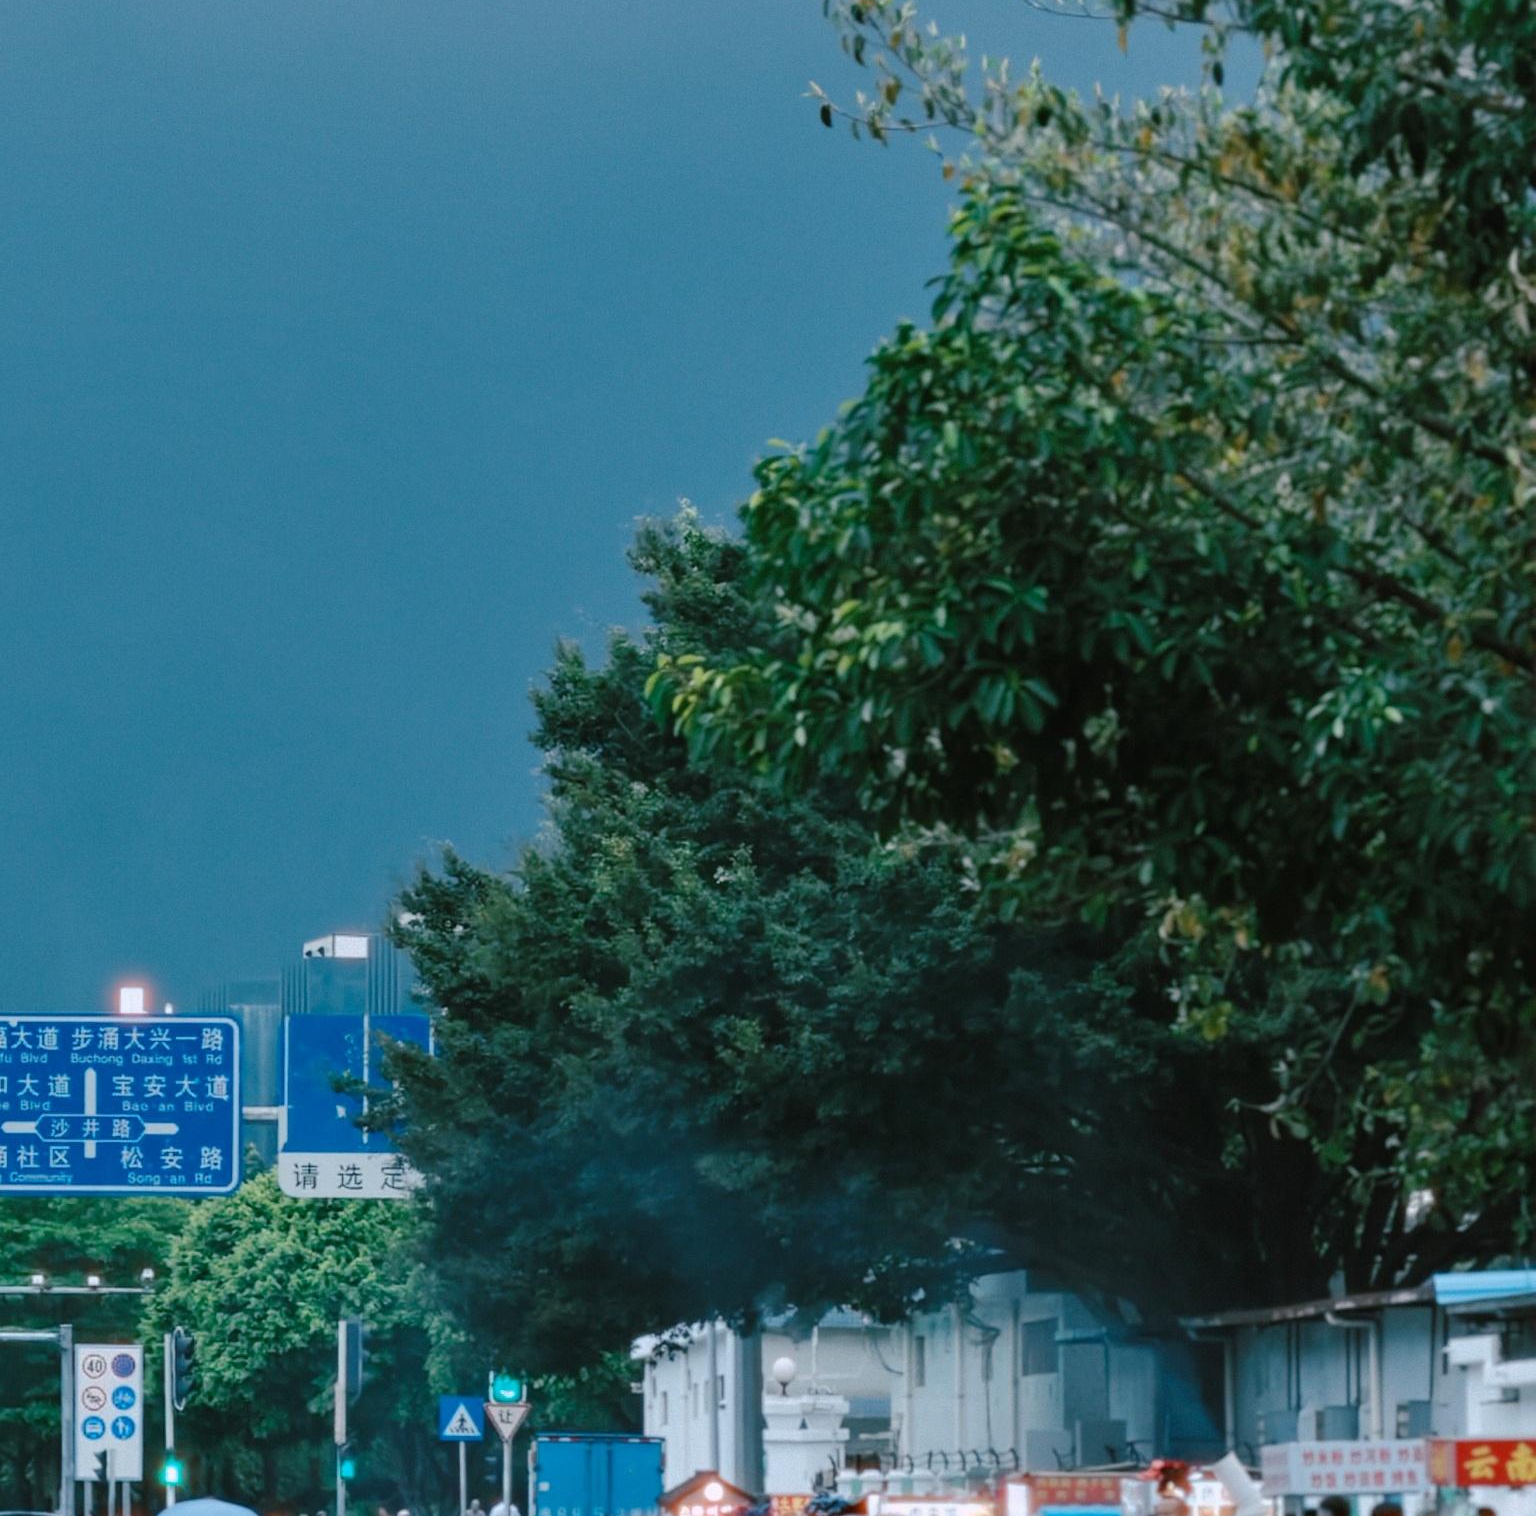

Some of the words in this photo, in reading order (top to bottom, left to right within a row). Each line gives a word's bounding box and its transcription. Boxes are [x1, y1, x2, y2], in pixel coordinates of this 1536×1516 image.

[71, 1026, 224, 1052] 步涌大兴一路
[20, 1051, 48, 1064] Blvd
[70, 1053, 124, 1067] Buchong
[206, 1053, 223, 1065] Rd
[112, 1073, 230, 1101] 宝安大道
[20, 1098, 51, 1111] Blvd
[184, 1100, 214, 1112] Blvd
[50, 1118, 131, 1138] 沙井路
[120, 1145, 224, 1171] 松安路
[194, 1172, 214, 1184] Rd
[86, 1360, 103, 1374] 40
[498, 1408, 513, 1424] 让
